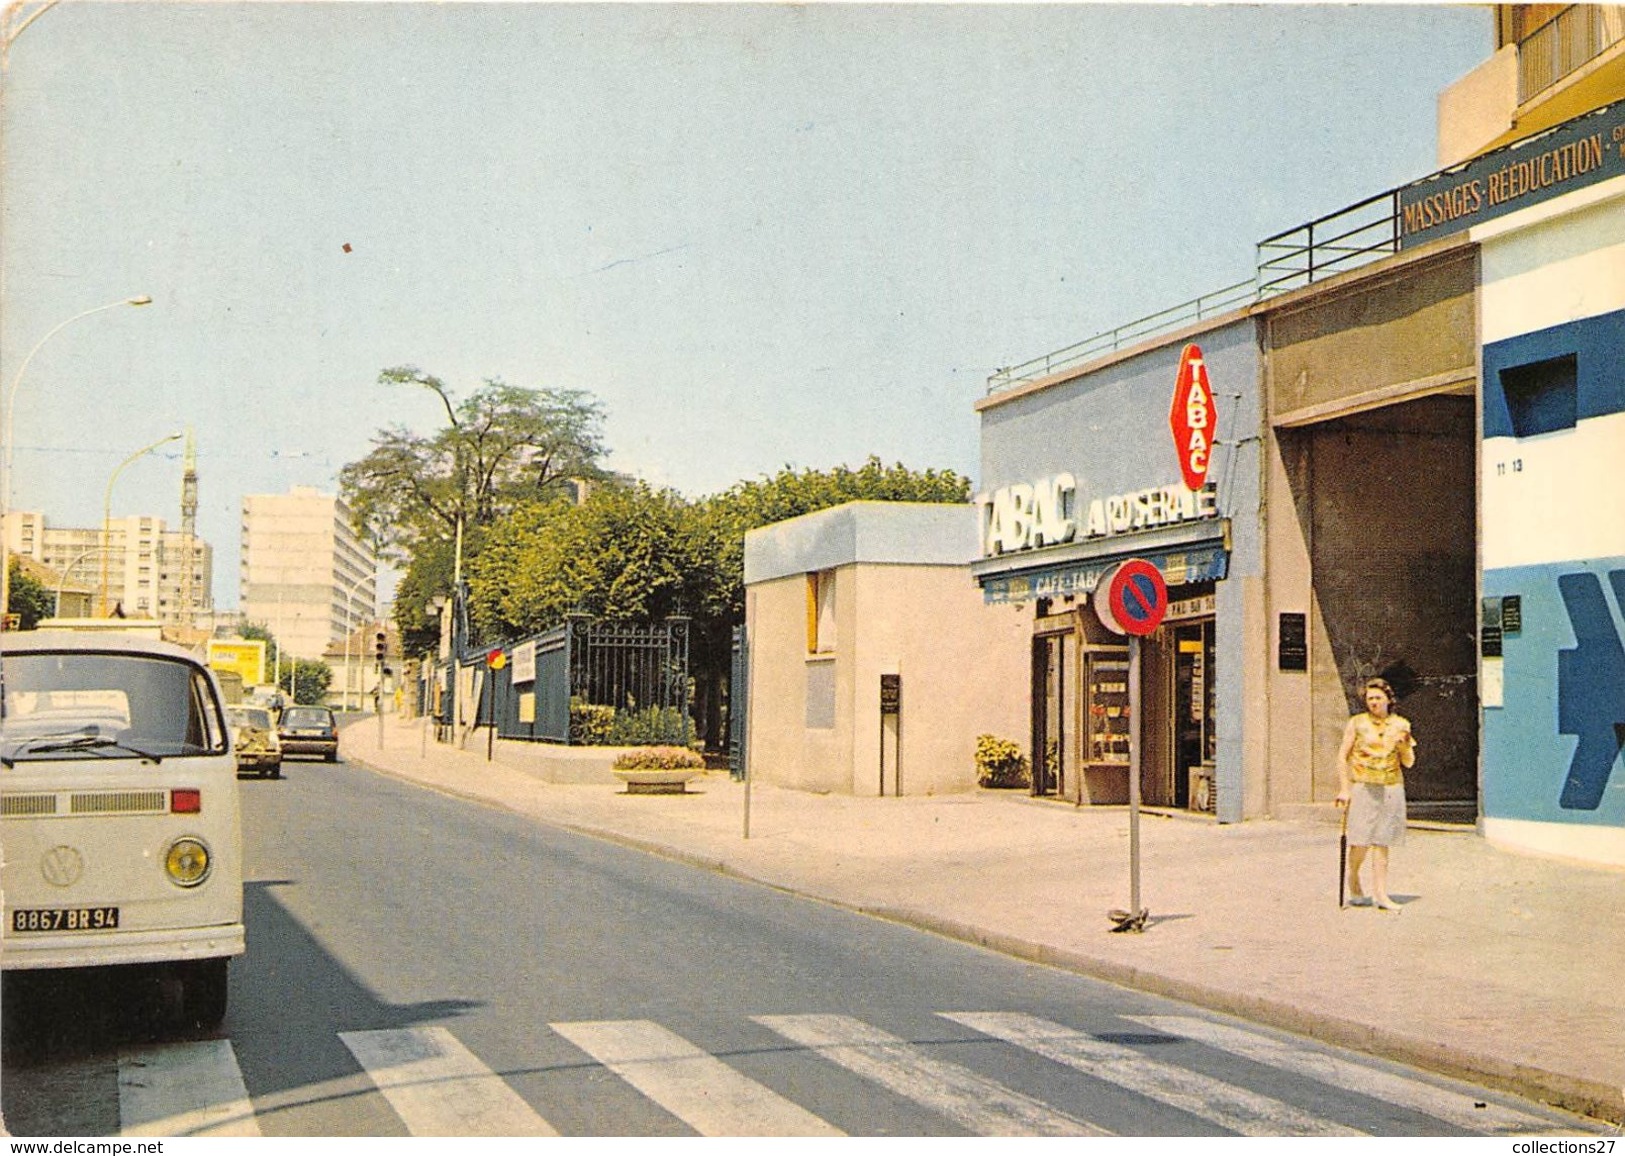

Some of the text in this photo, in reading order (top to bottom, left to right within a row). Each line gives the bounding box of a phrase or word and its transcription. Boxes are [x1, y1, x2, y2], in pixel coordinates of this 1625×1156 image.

[1403, 180, 1482, 234] MASSAGES
[1488, 133, 1602, 206] RÉÉDUCATION
[1187, 359, 1207, 473] TABAC
[974, 473, 1076, 556] TABAC
[17, 911, 62, 929] 8867
[94, 909, 114, 927] 94
